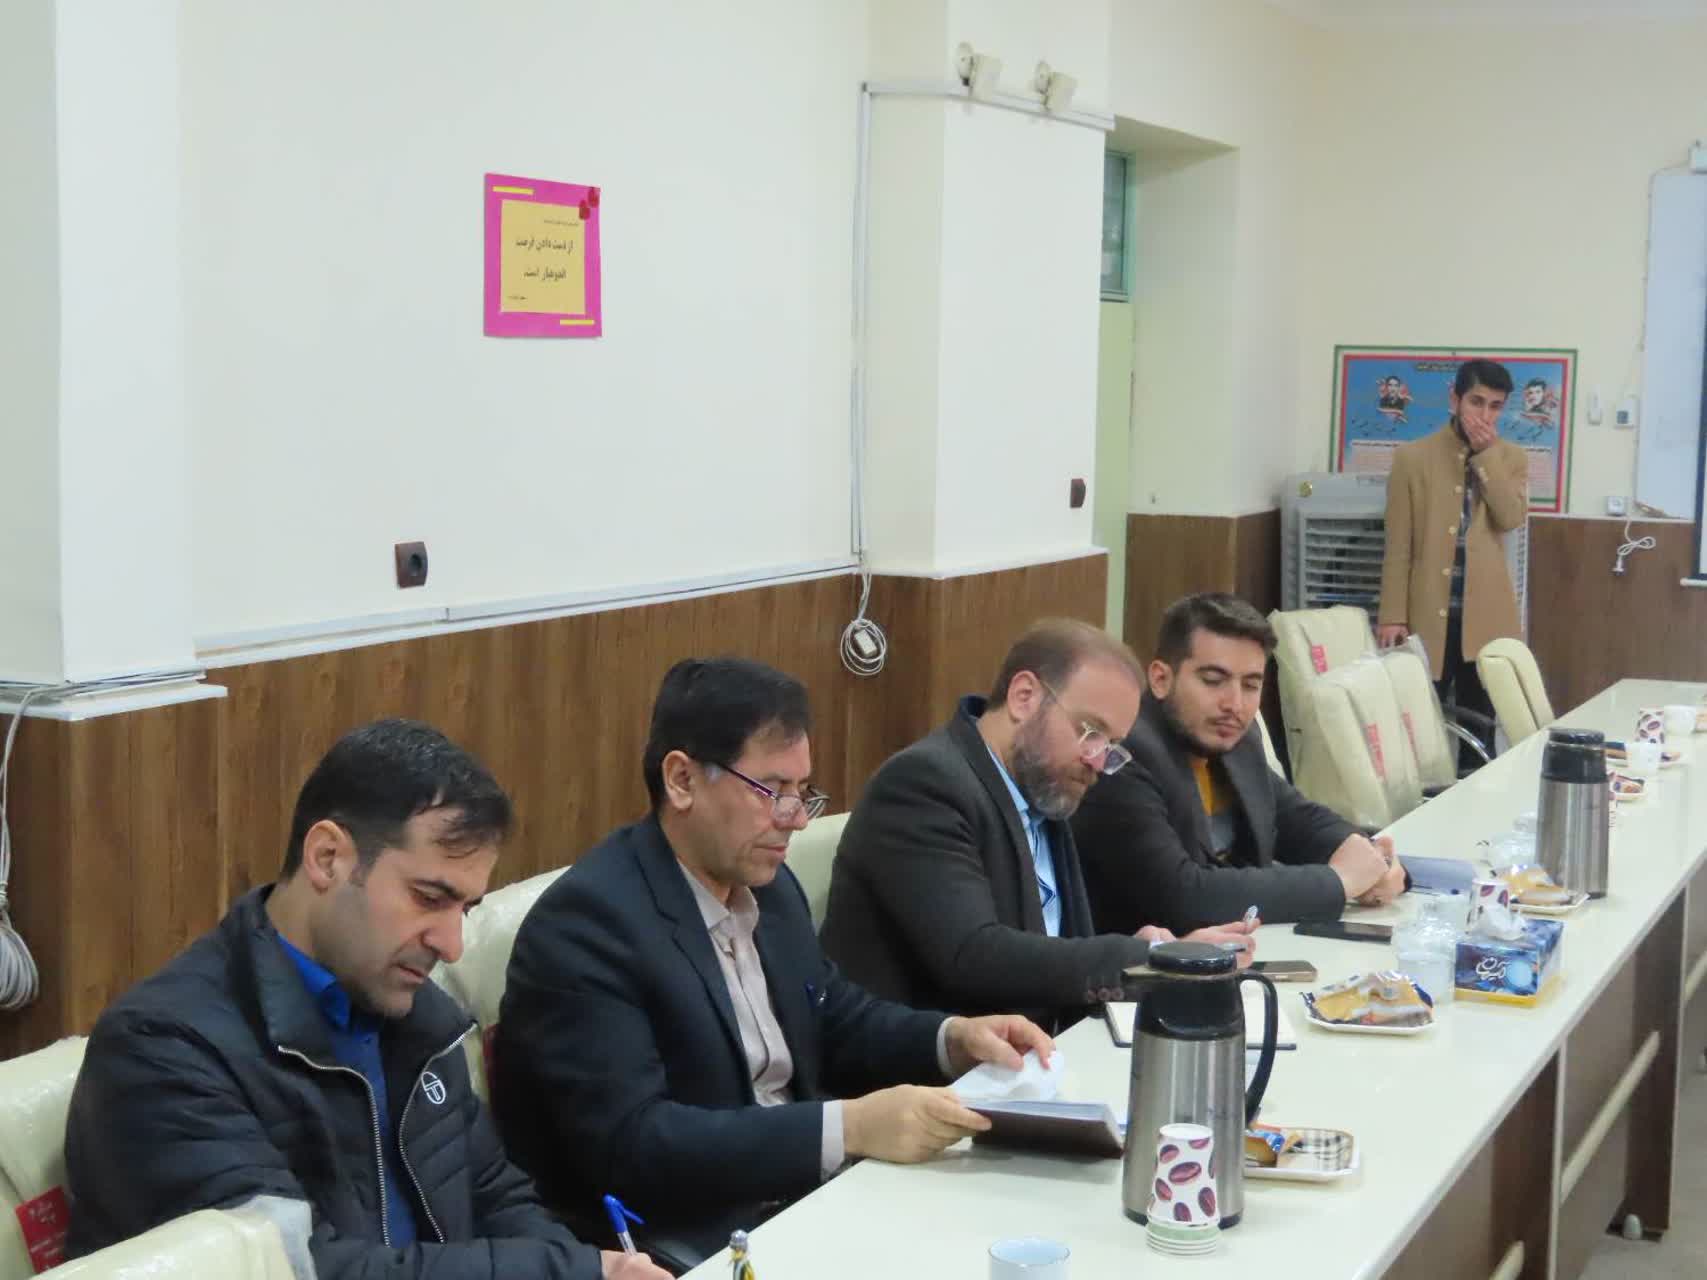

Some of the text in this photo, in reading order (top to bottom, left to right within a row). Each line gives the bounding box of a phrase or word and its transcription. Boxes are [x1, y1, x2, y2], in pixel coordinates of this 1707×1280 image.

[536, 237, 552, 251] دادن
[552, 239, 567, 250] دست
[523, 267, 540, 278] است
